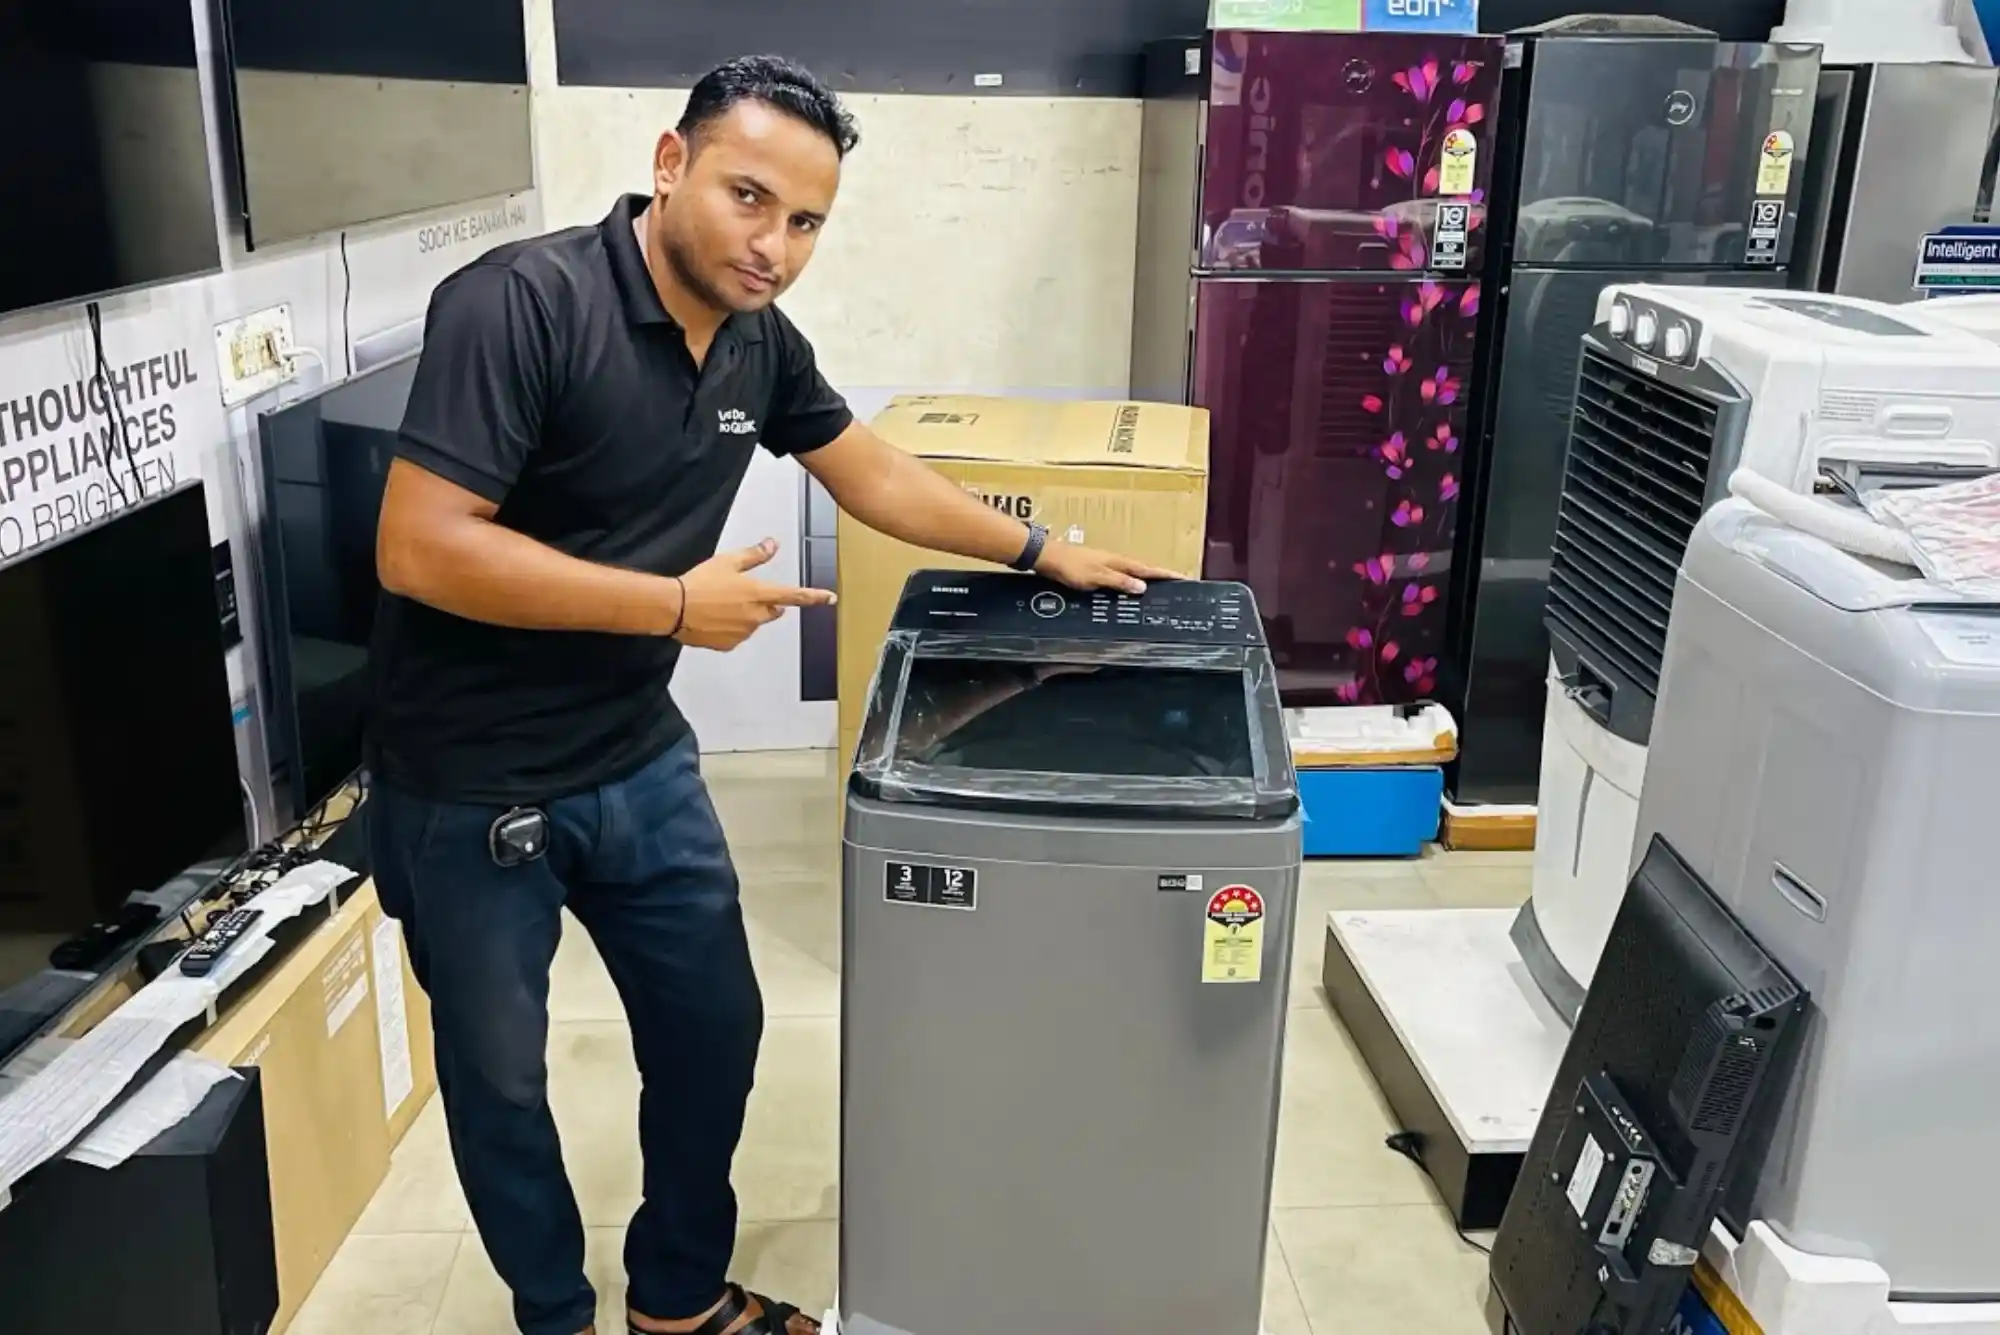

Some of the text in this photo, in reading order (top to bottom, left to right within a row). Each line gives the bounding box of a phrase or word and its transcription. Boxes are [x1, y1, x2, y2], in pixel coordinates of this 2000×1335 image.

[419, 223, 452, 254] SOCH
[452, 217, 468, 244] KE
[1926, 240, 1998, 261] Intelligent
[0, 403, 177, 504] PPLIANCES
[900, 865, 964, 887] 3 12
